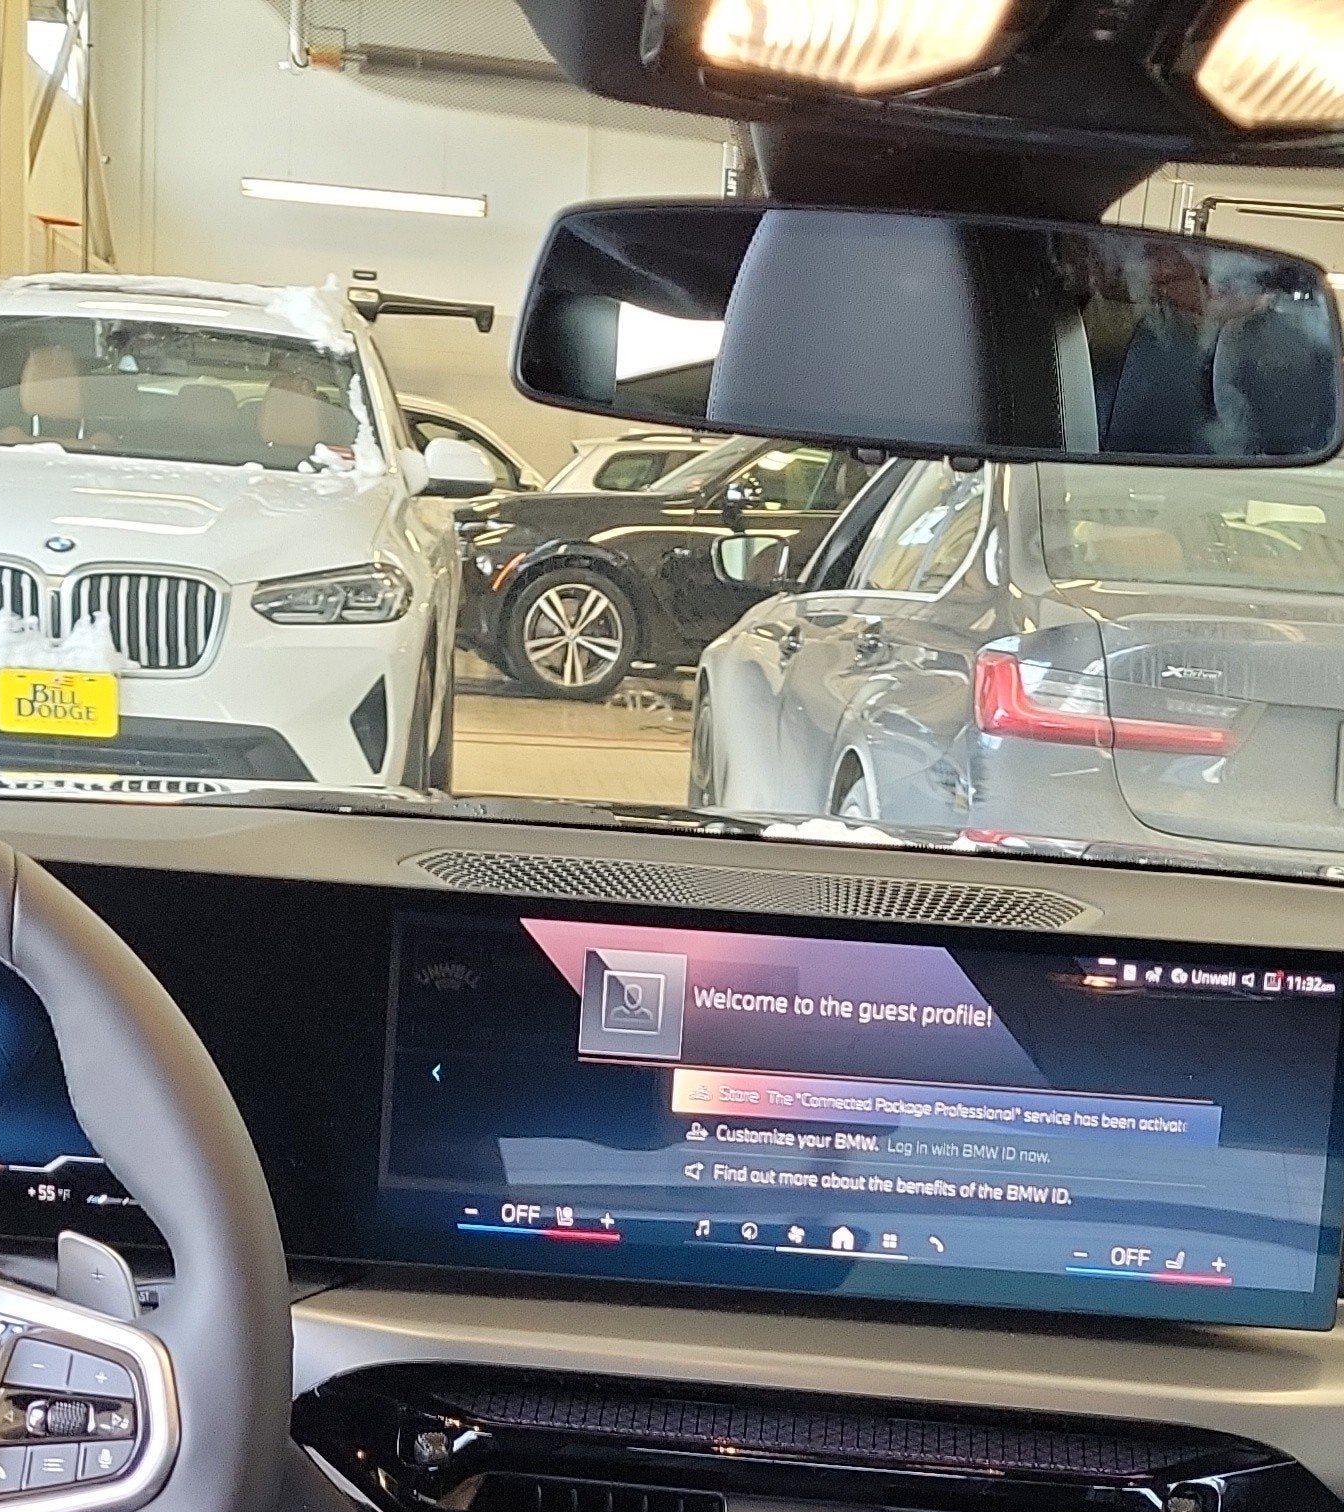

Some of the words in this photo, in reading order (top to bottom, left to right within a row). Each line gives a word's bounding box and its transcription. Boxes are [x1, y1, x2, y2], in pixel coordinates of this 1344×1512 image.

[1191, 969, 1237, 986] Unwell
[693, 985, 789, 1014] Welcome
[794, 994, 814, 1015] to
[820, 994, 854, 1018] the
[858, 1001, 918, 1024] guest
[921, 1003, 993, 1028] profile!
[766, 1089, 794, 1106] The
[875, 1097, 932, 1118] Package
[1023, 1110, 1071, 1126] service
[1074, 1111, 1099, 1128] has
[1101, 1112, 1136, 1130] been
[716, 1123, 796, 1146] Customize
[797, 1133, 832, 1149] your
[834, 1131, 879, 1151] BMW.
[887, 1137, 914, 1157] Log
[916, 1139, 928, 1155] in
[931, 1142, 959, 1158] with
[962, 1143, 1000, 1160] BMW
[1001, 1146, 1017, 1161] ID
[1019, 1149, 1051, 1164] now.
[713, 1163, 747, 1182] Find
[750, 1169, 776, 1184] out
[778, 1172, 818, 1187] more
[821, 1172, 866, 1191] about
[868, 1174, 893, 1192] the
[895, 1175, 957, 1197] benefits
[959, 1180, 977, 1198] of
[978, 1182, 1004, 1200] the
[1006, 1184, 1049, 1204] BMW
[1051, 1187, 1072, 1206] ID.
[501, 1203, 541, 1224] OFF
[1110, 1247, 1152, 1267] OFF
